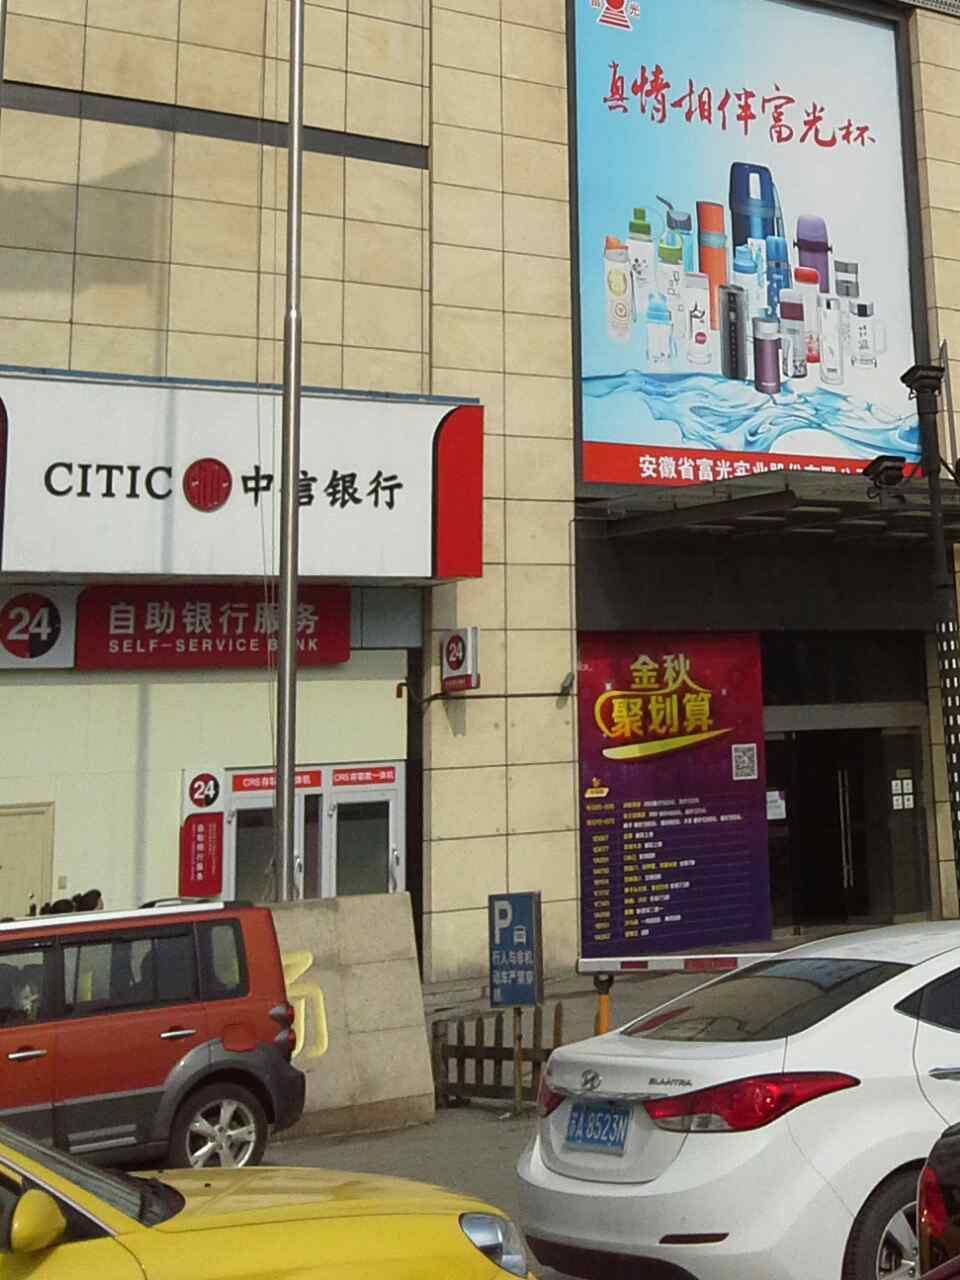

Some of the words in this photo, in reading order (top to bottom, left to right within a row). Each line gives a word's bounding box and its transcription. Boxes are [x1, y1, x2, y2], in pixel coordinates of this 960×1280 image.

[603, 60, 877, 148] 真情相伴富光杯
[44, 461, 174, 501] CITIC
[7, 607, 51, 641] 24
[109, 601, 319, 636] 自助银行服务
[109, 638, 260, 653] SELF-SERVICE
[267, 638, 319, 652] BNK
[449, 639, 464, 662] 24
[630, 652, 692, 690] 金秋
[611, 692, 714, 737] 聚划算
[194, 780, 216, 800] 24
[494, 900, 512, 945] P
